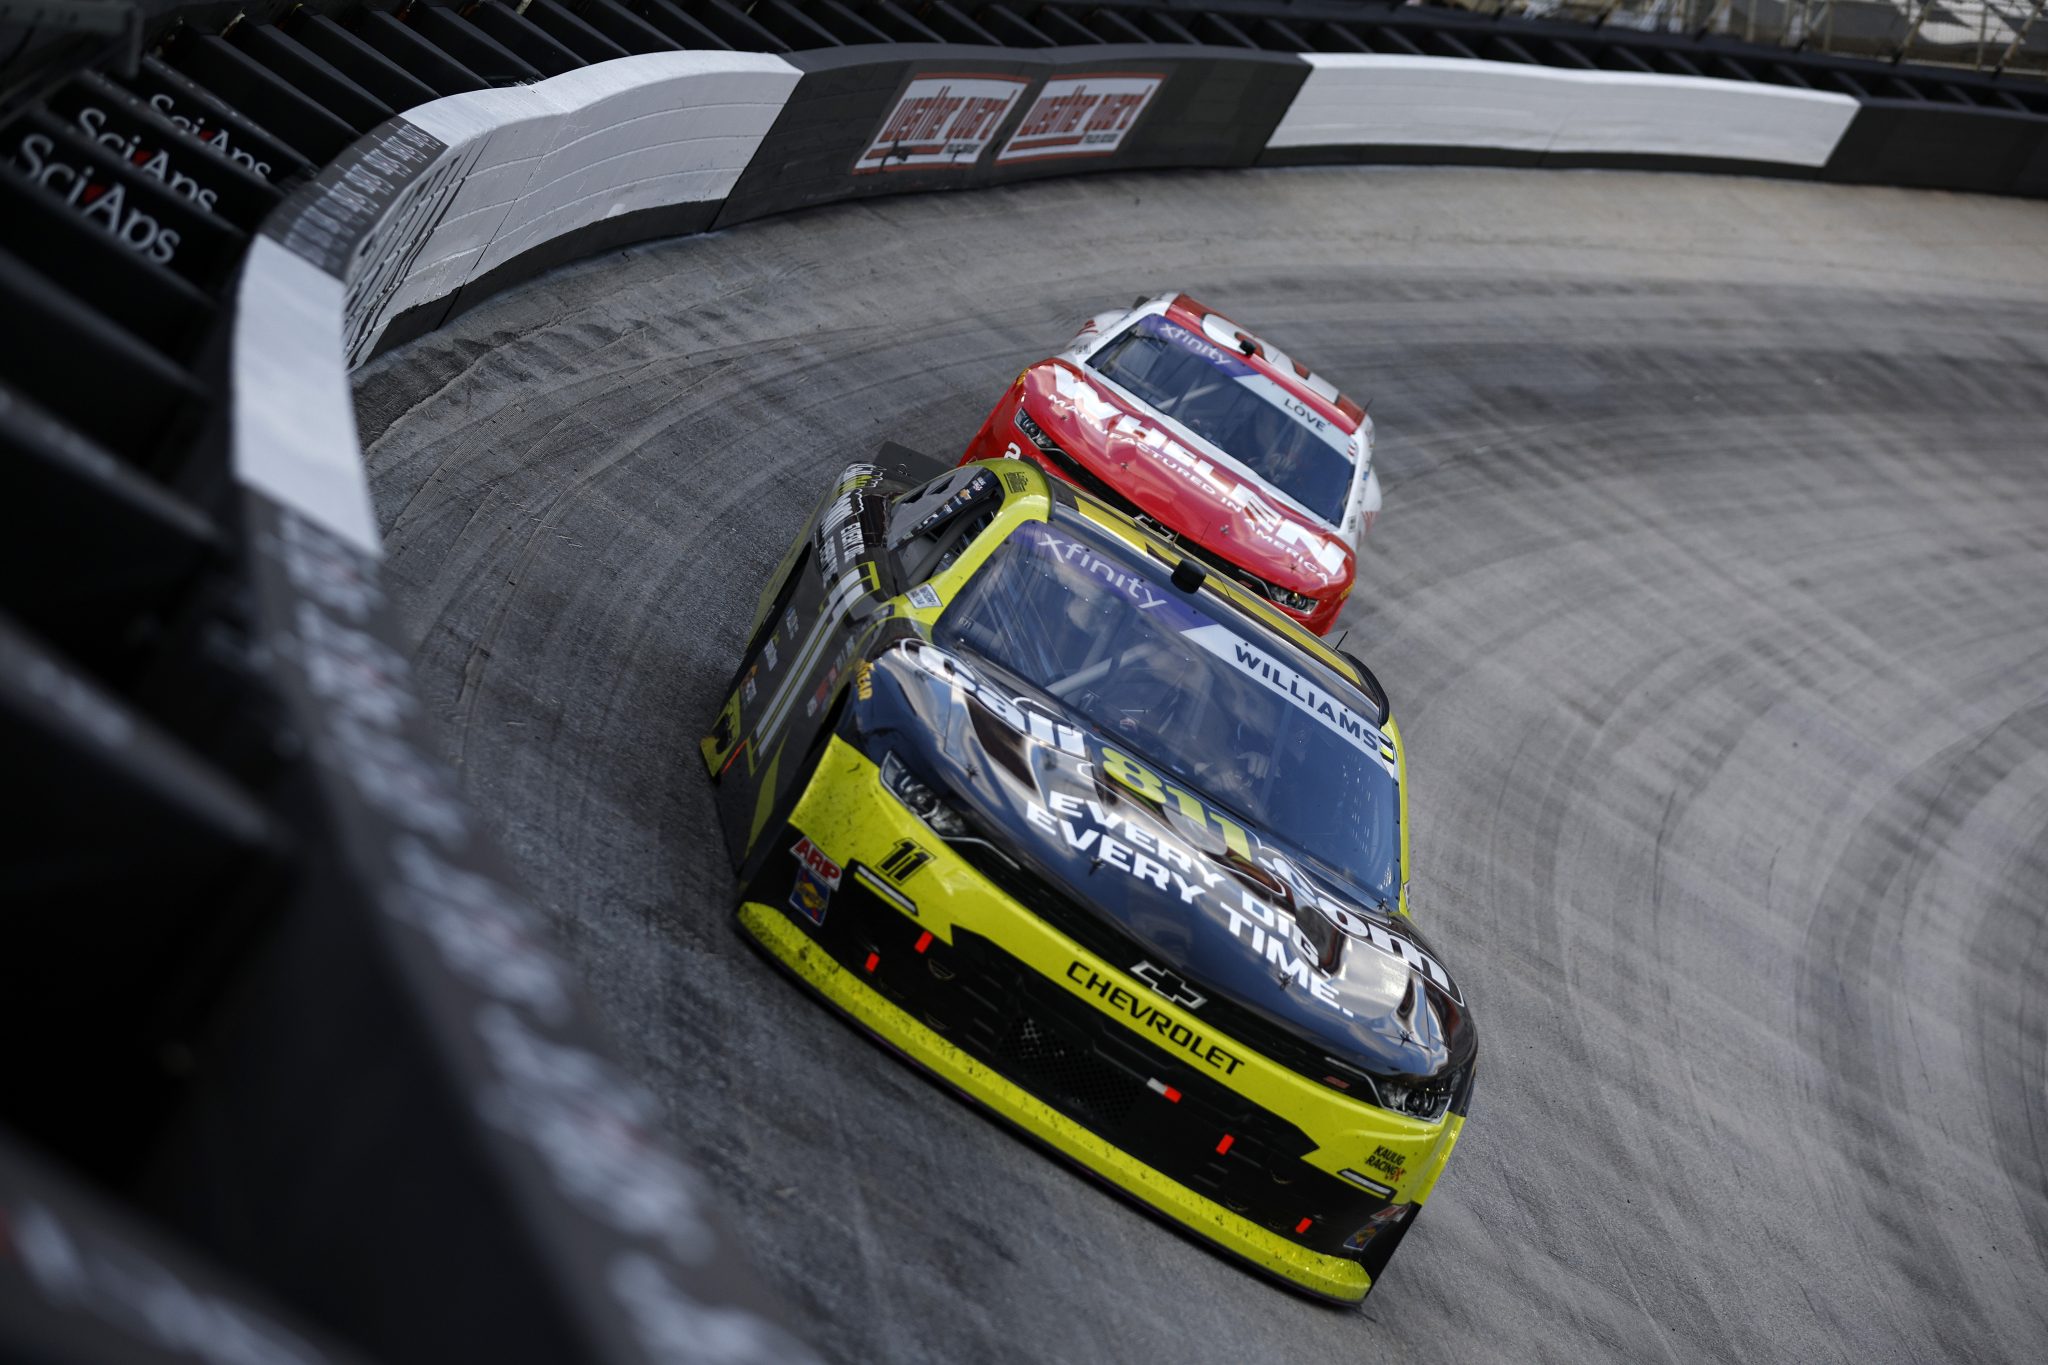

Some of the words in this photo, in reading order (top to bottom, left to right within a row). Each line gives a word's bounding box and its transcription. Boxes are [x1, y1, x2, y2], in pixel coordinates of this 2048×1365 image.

[1284, 398, 1327, 433] LOVE
[1053, 363, 1347, 576] WHELEN
[1220, 497, 1242, 513] IN
[1244, 518, 1328, 586] AMERICA
[1235, 644, 1378, 751] WILLIAMS
[794, 837, 841, 880] ARP
[877, 838, 935, 885] 11
[1049, 790, 1225, 888] EVERY
[1026, 800, 1206, 904] EVERY
[1220, 902, 1354, 1018] TIME.
[1066, 961, 1245, 1076] CHEVROLET
[1372, 1144, 1406, 1166] KAULIG
